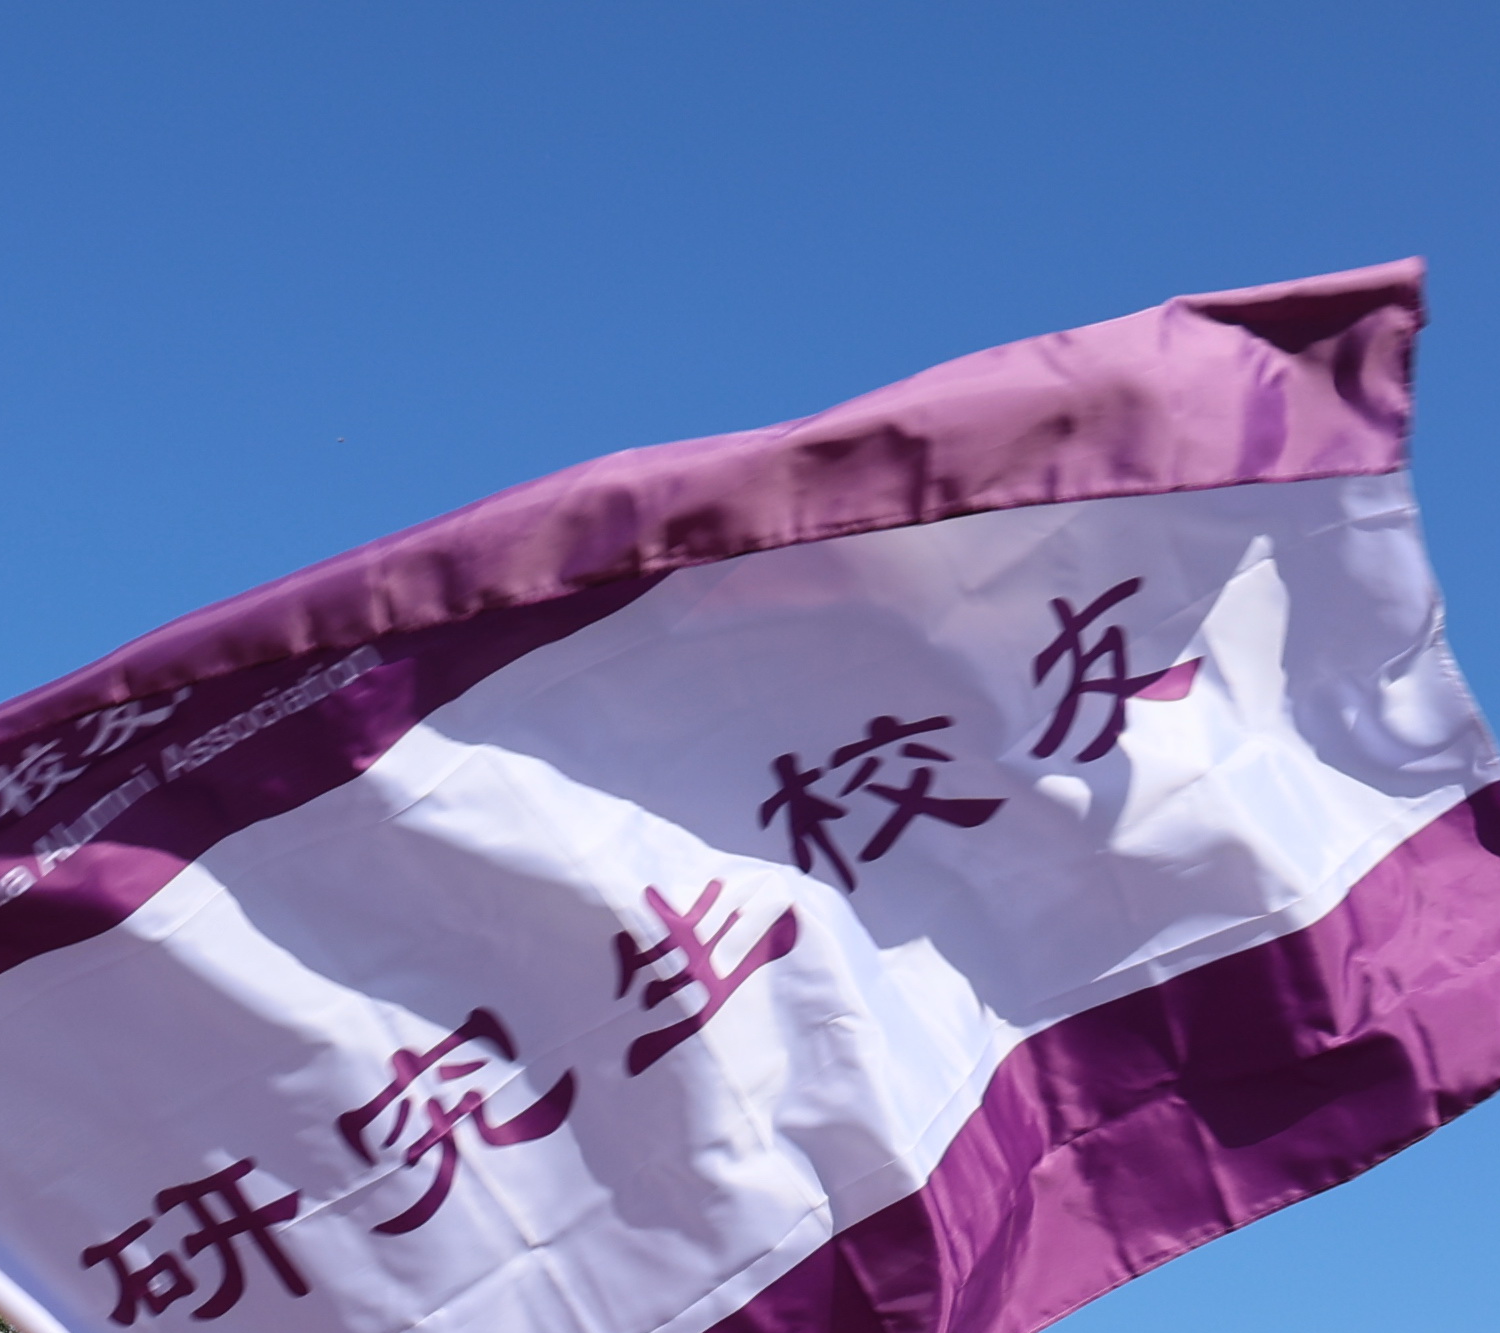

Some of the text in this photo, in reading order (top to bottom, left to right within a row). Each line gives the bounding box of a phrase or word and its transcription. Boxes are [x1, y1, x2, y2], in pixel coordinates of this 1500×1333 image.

[80, 575, 1203, 1327] 研究生校友
